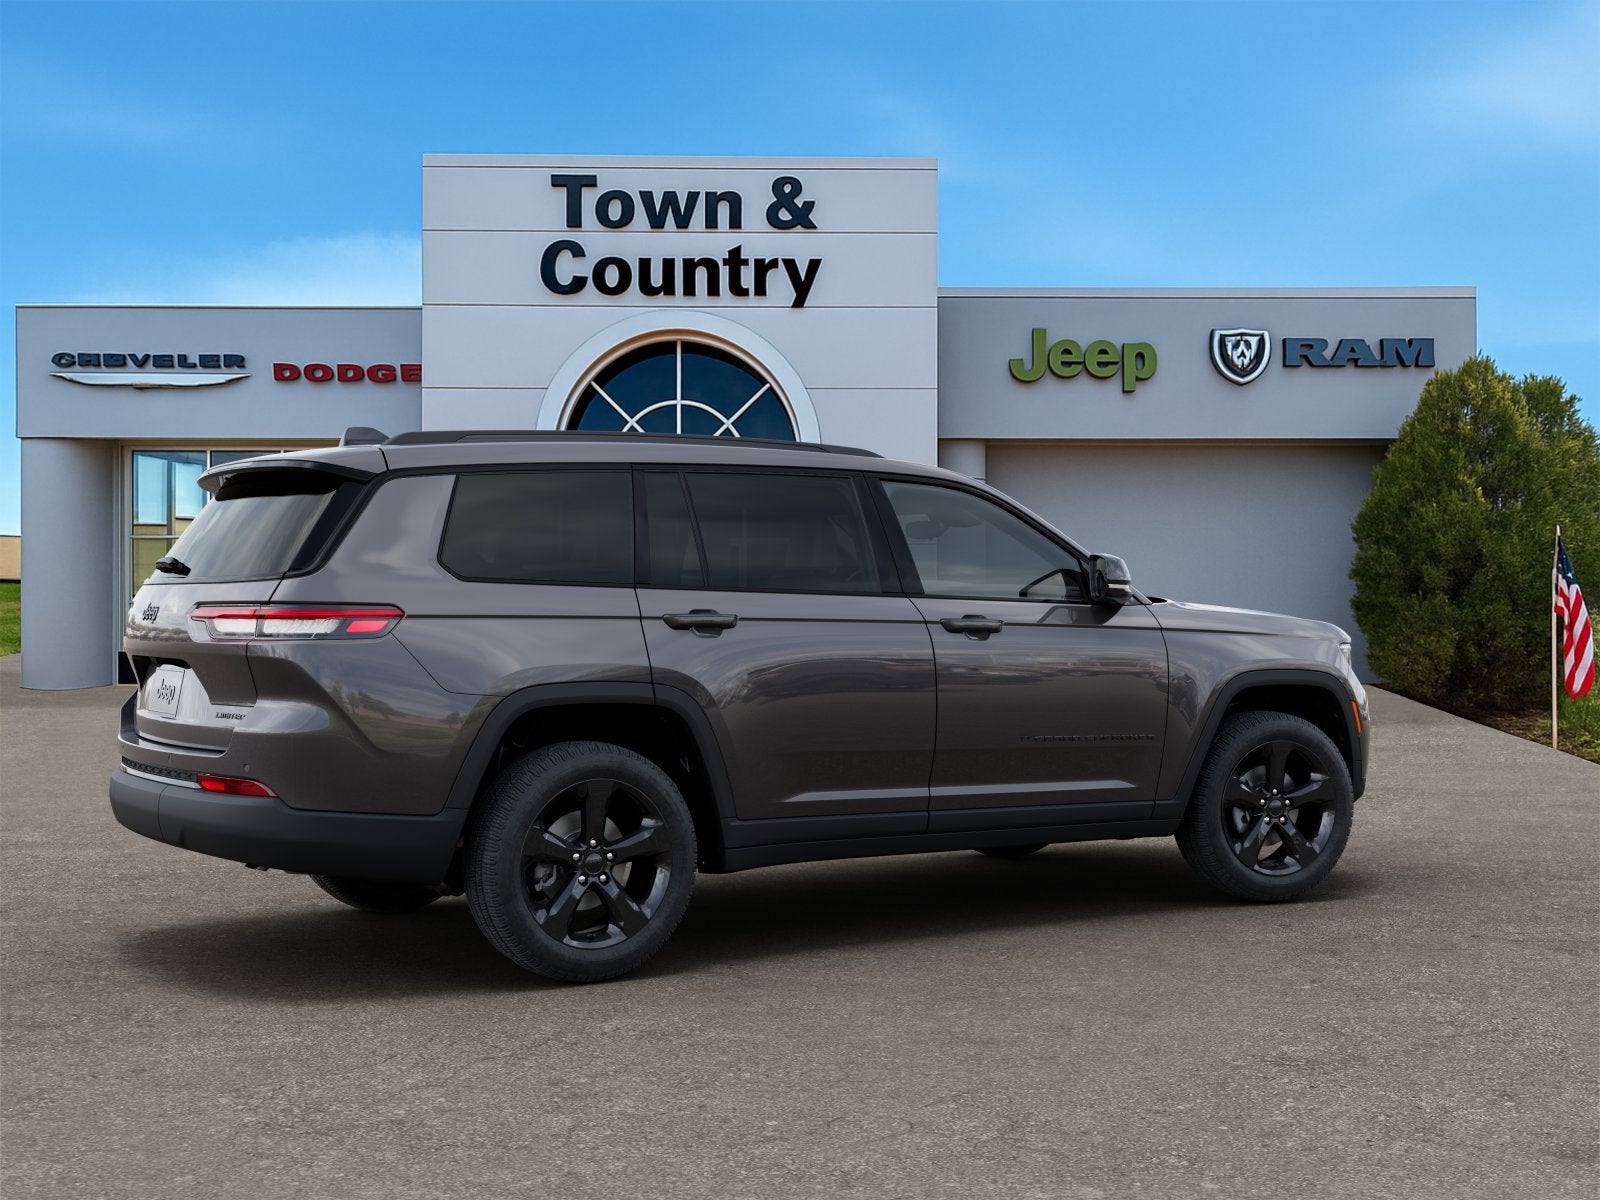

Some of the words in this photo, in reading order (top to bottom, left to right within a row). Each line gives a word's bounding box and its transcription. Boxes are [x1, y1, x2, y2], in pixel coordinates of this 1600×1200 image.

[550, 174, 743, 229] Town
[765, 175, 819, 230] &
[540, 239, 823, 308] Country
[273, 363, 422, 383] DODGE
[1009, 328, 1157, 393] Jeep
[1283, 337, 1435, 367] RAM
